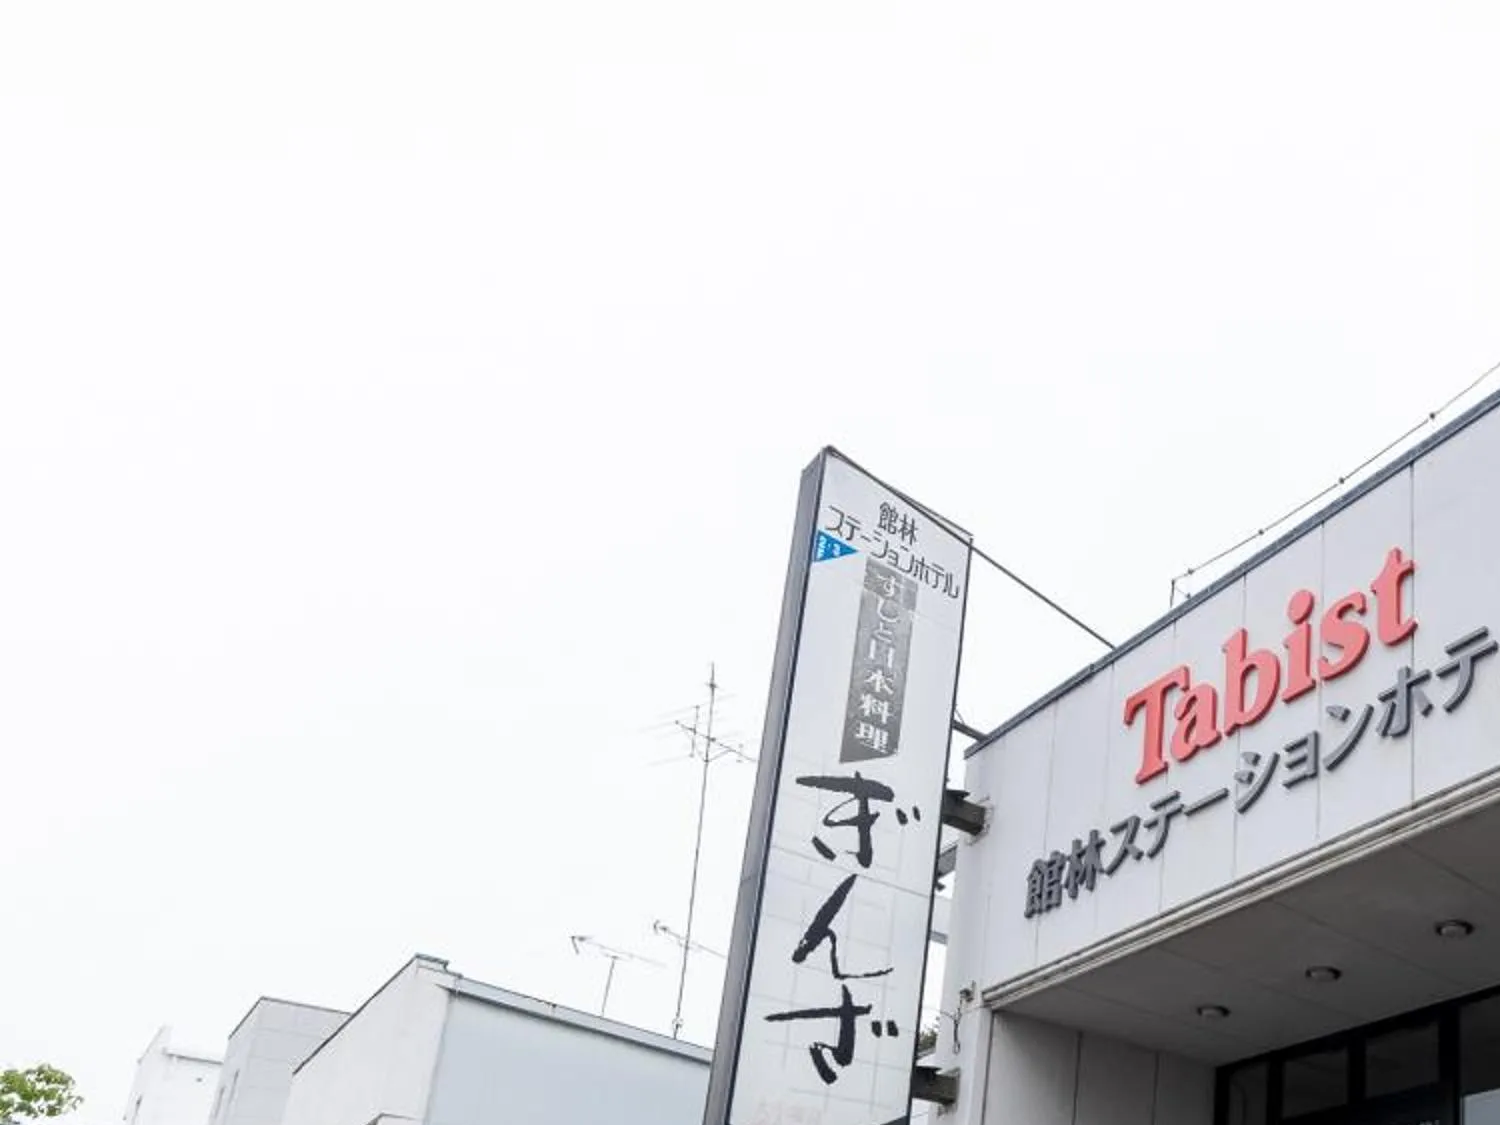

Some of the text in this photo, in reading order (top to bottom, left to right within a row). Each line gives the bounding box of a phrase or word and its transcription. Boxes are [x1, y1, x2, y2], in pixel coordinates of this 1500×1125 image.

[825, 505, 960, 600] ステーションホテル
[878, 502, 918, 547] 館林
[1123, 547, 1419, 786] Tabist
[765, 771, 921, 1085] ぎんざ
